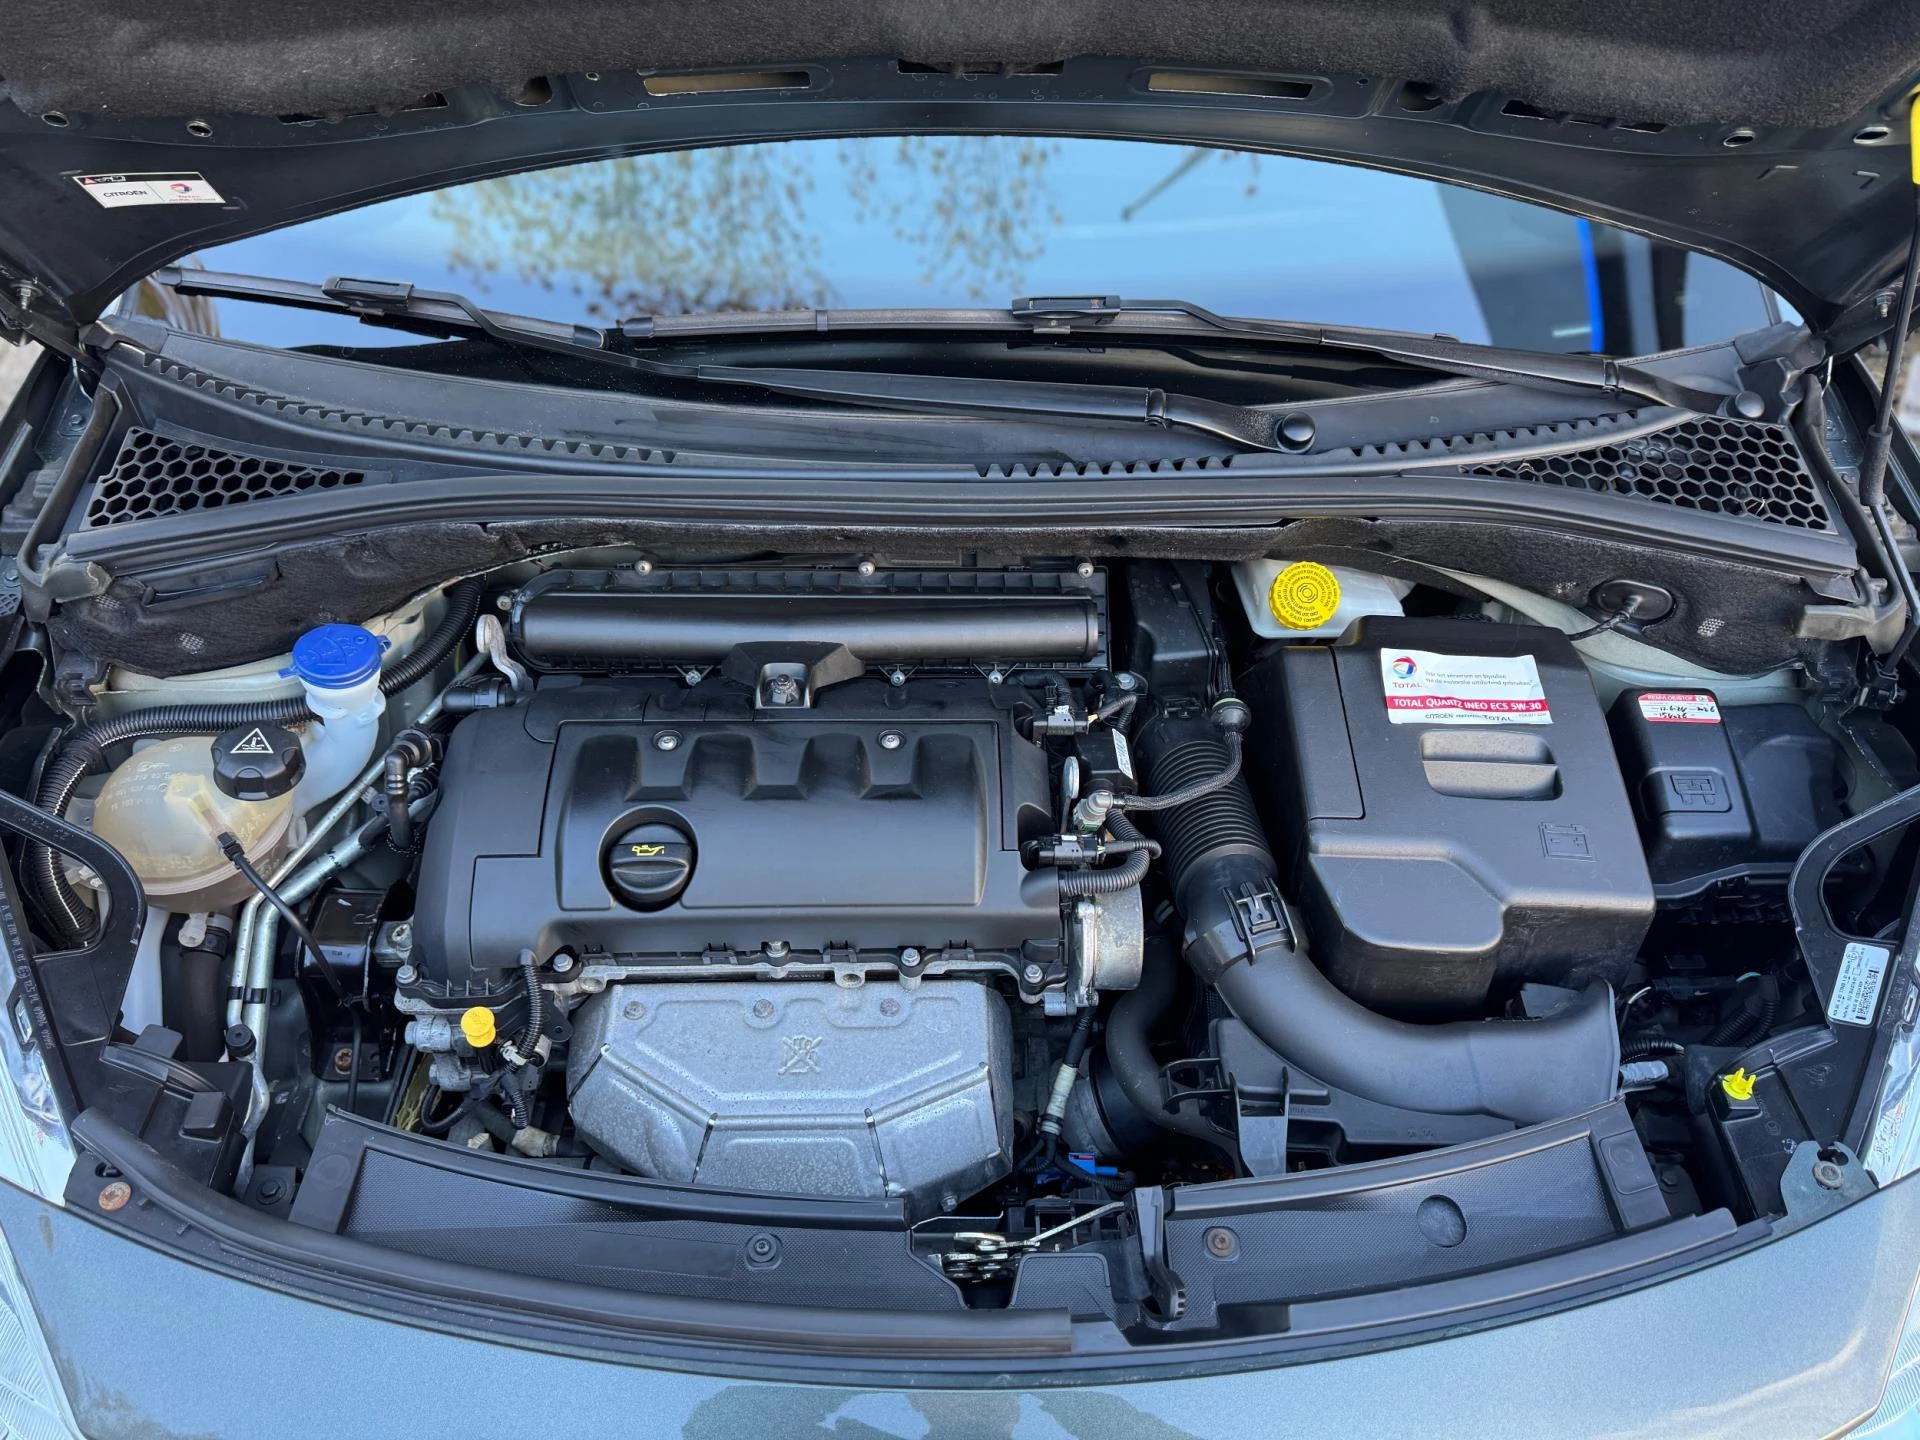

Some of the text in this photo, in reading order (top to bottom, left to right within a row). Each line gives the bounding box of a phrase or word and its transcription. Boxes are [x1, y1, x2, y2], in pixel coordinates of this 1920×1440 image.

[1393, 698, 1542, 711] TOTAL QUARTZ INEO ECS 5W-30
